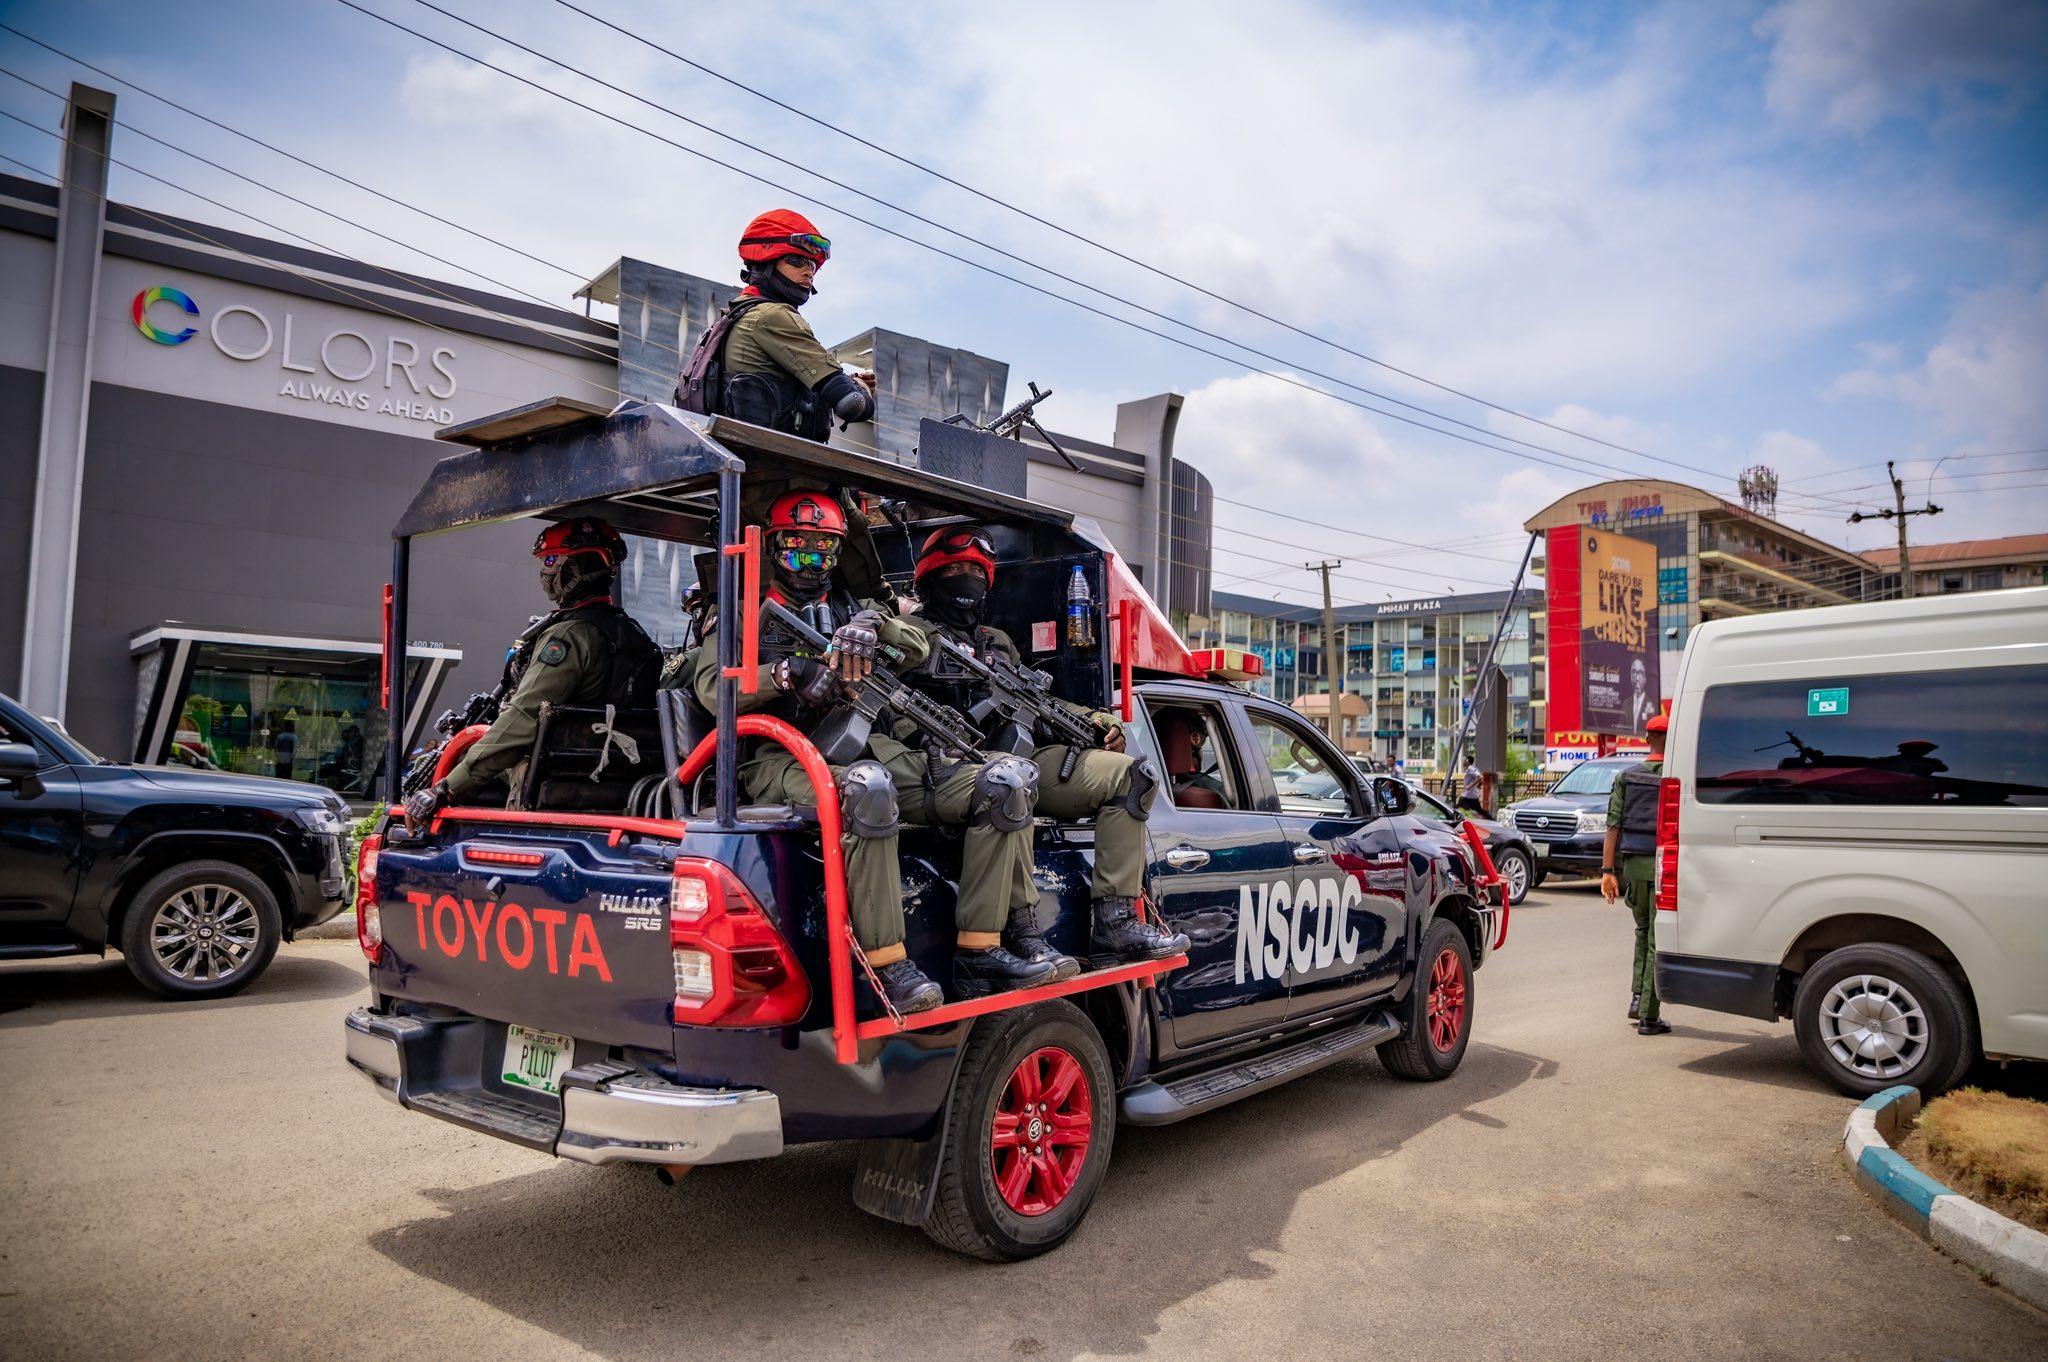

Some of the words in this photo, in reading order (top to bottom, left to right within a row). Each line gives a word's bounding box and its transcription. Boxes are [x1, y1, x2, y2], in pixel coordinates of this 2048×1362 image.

[131, 285, 458, 400] COLORS
[280, 379, 370, 411] ALWAYS
[377, 397, 454, 426] AHEAD
[1577, 500, 1607, 516] THE
[1599, 568, 1620, 584] DARE
[1621, 573, 1632, 586] TO
[1632, 576, 1643, 588] BE
[1413, 600, 1441, 612] PLAZA
[1598, 581, 1643, 619] LIKE
[1594, 611, 1648, 649] CHRIST
[1560, 752, 1589, 760] HOME
[600, 893, 664, 916] HILUX
[407, 890, 613, 983] TOYOTA
[624, 916, 663, 932] SR5
[1235, 874, 1362, 985] NSCDC
[536, 1034, 557, 1046] DEFENCE
[520, 1044, 557, 1080] PILOT
[863, 1168, 926, 1200] HILUX
